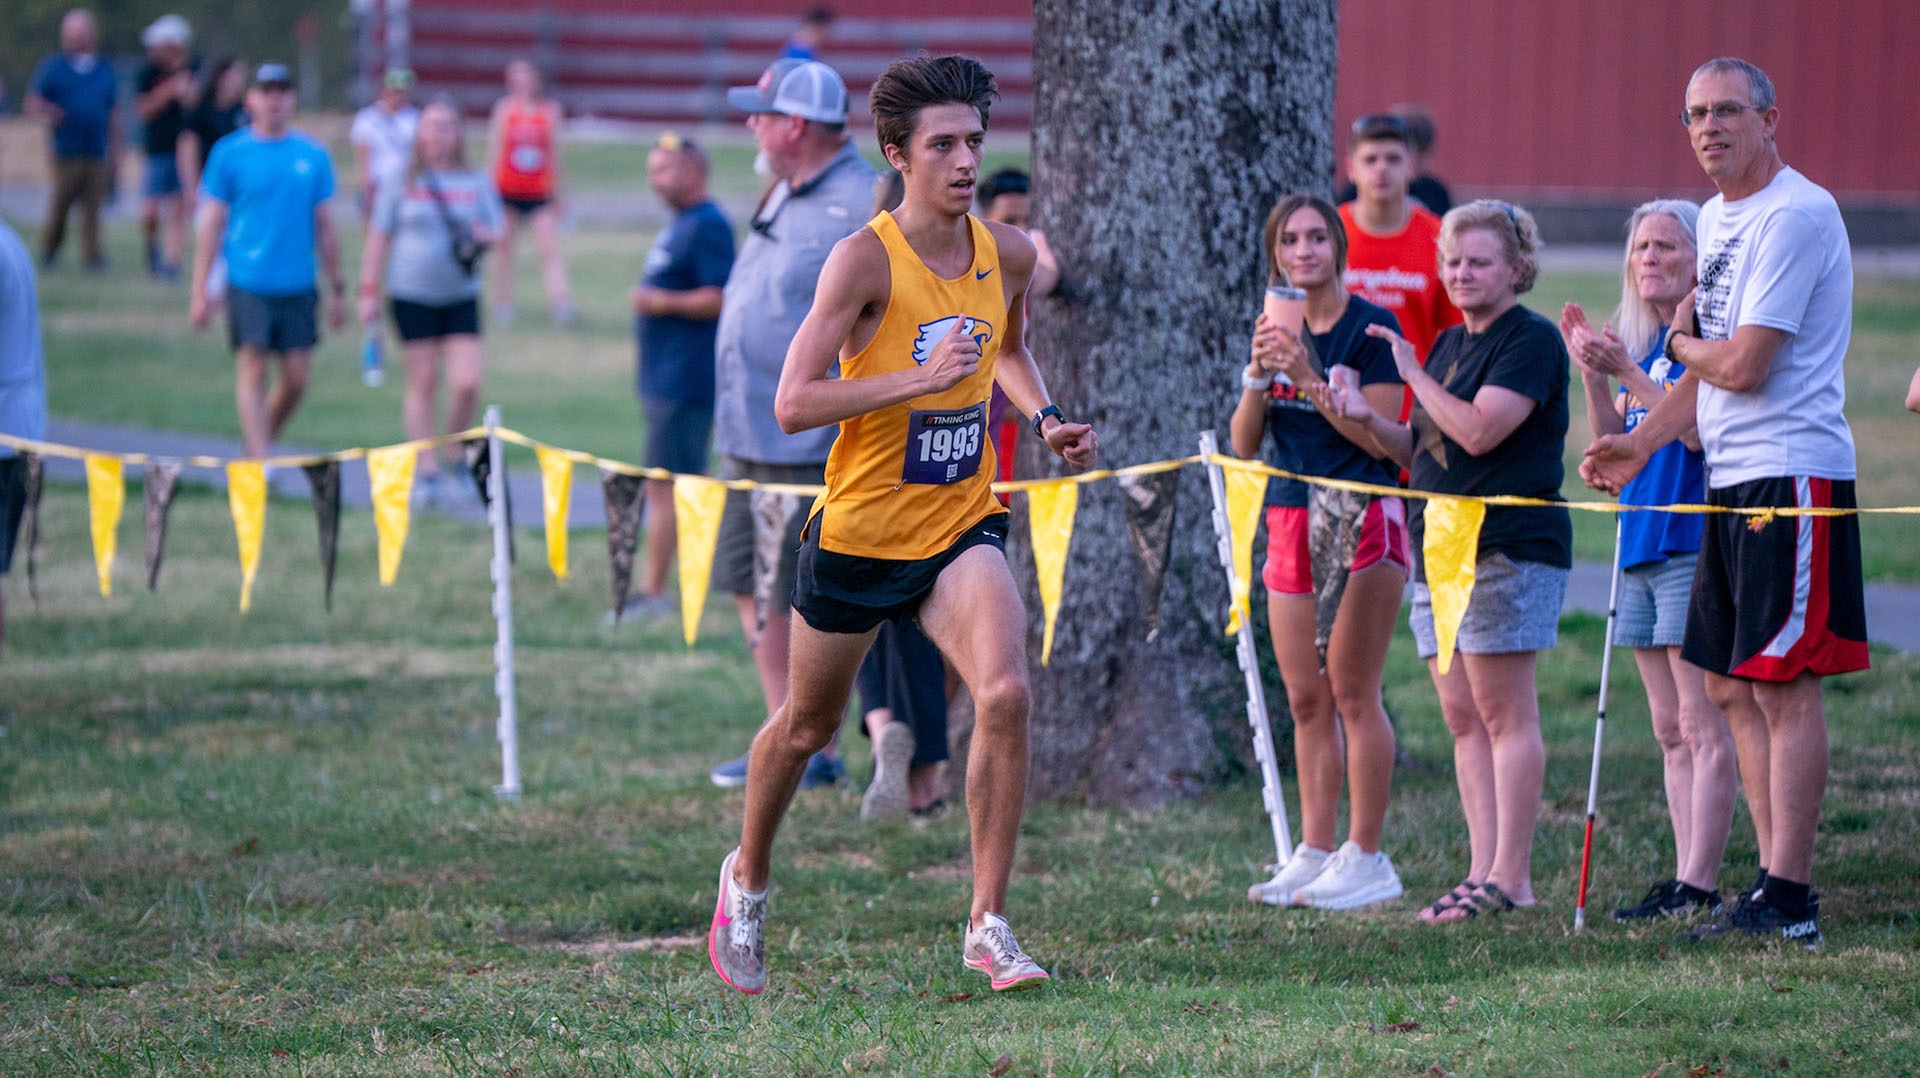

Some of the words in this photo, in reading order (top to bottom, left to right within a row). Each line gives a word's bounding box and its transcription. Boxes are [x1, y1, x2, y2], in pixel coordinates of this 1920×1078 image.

[964, 410, 980, 421] KING
[917, 423, 980, 462] 1993
[1782, 920, 1817, 938] HOKA
